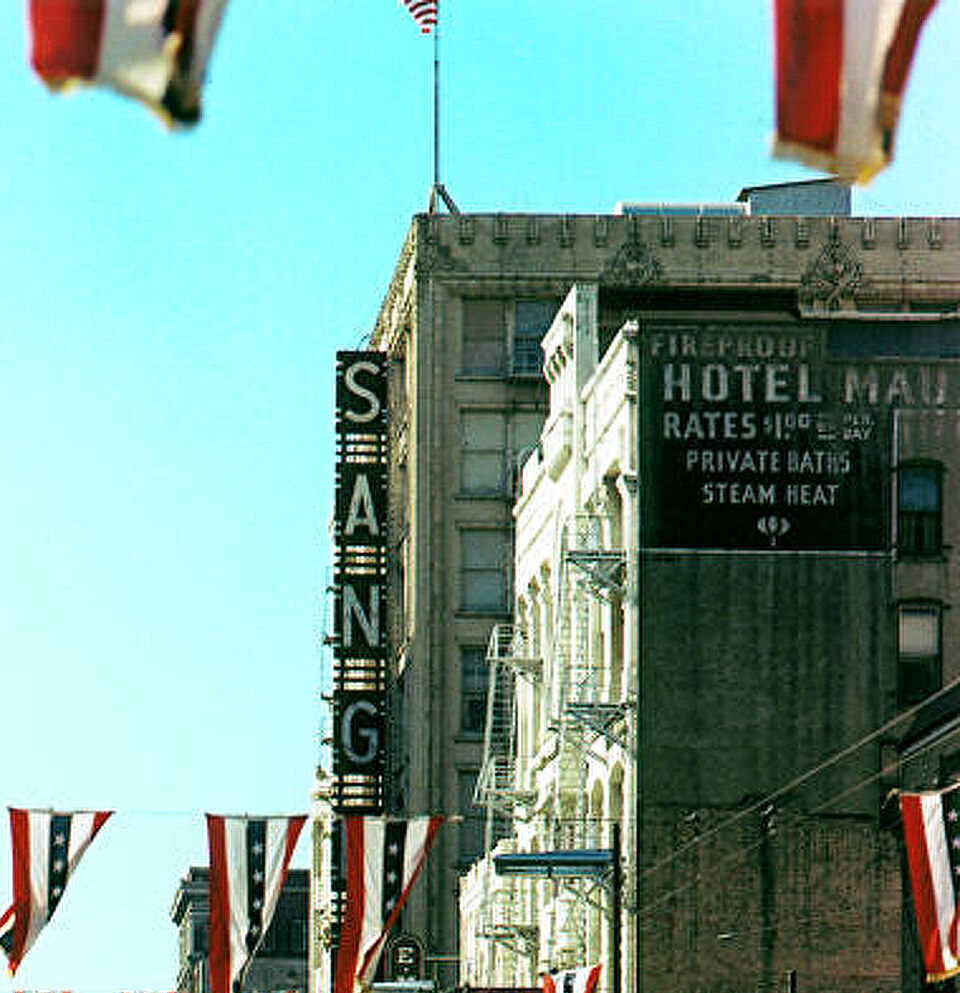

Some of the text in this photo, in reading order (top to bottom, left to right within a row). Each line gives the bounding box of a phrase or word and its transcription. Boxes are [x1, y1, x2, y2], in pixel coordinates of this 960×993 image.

[663, 363, 823, 403] HOTEL
[663, 411, 757, 440] RATES
[686, 450, 780, 473] PRIVATE
[702, 483, 840, 505] STEAM HEAT
[342, 360, 381, 764] SANG
